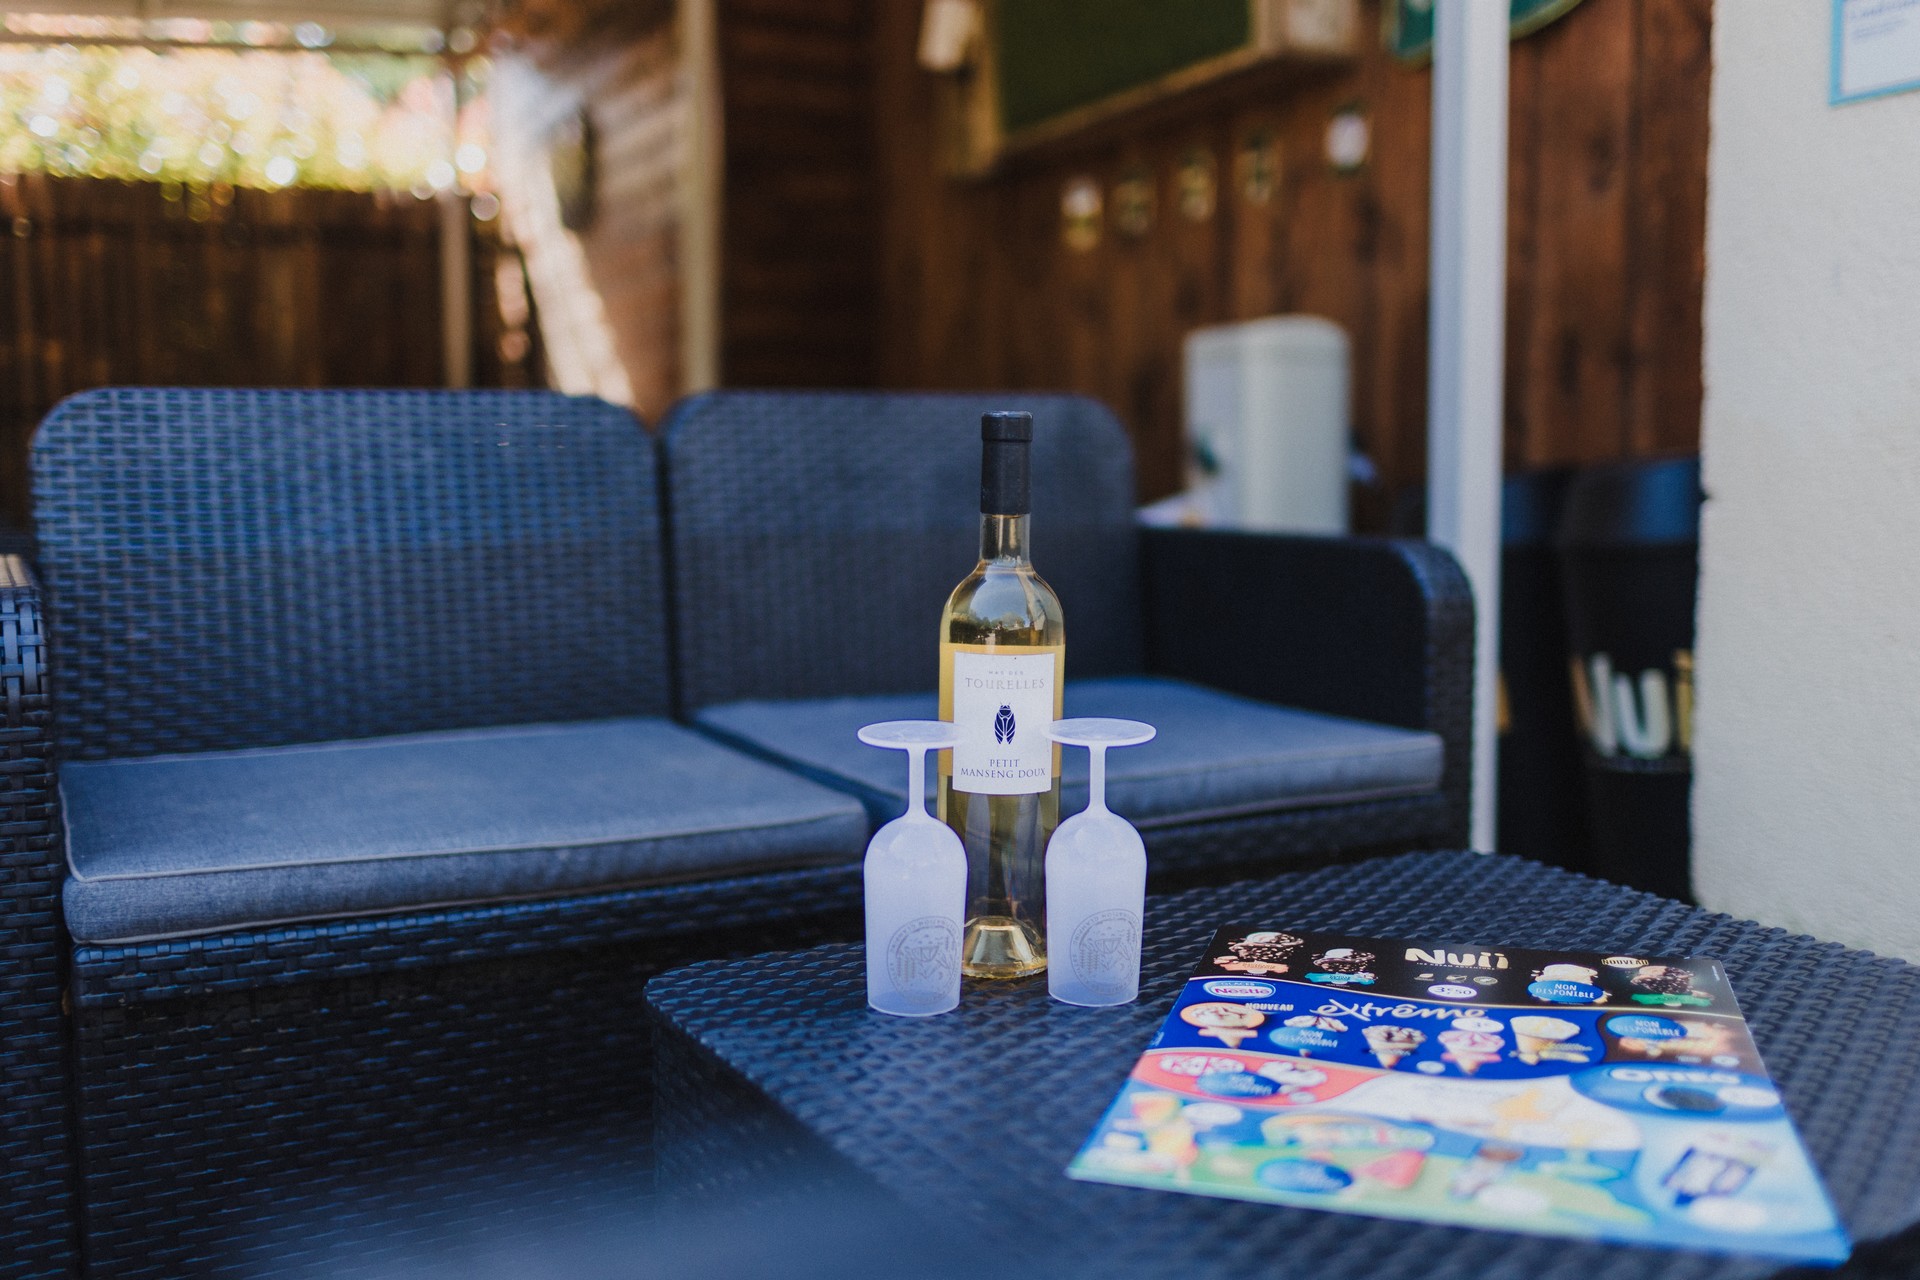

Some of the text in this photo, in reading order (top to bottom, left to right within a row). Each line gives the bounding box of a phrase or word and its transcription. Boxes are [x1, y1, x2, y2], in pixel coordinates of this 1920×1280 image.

[965, 677, 1045, 690] TOURELLES
[989, 758, 1020, 768] PETIT
[960, 767, 1046, 779] MANSENG DOUX
[1601, 958, 1649, 966] NOUVEAU
[1554, 983, 1577, 991] NON
[1535, 987, 1595, 999] DISPONIBLE
[1245, 1003, 1294, 1011] NOUVEAU
[1634, 1019, 1660, 1028] NON
[1615, 1024, 1681, 1037] DISPONIBLE
